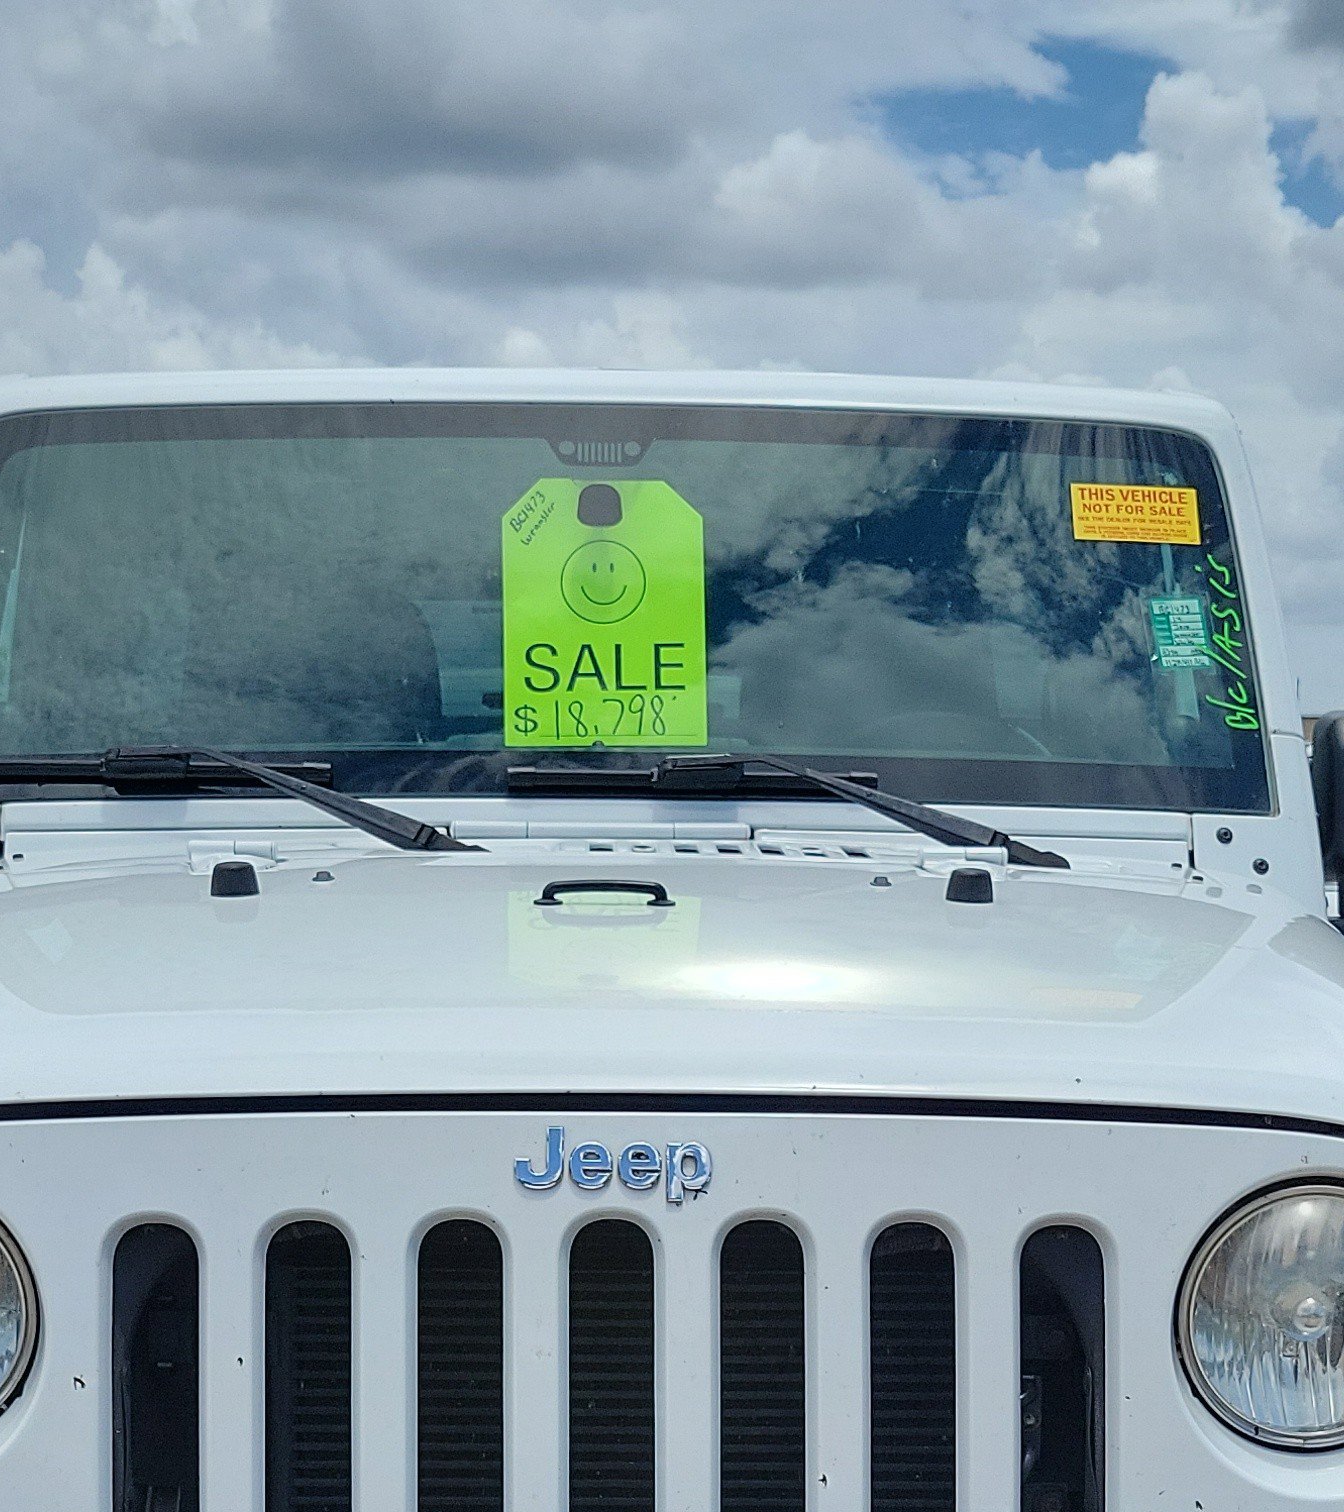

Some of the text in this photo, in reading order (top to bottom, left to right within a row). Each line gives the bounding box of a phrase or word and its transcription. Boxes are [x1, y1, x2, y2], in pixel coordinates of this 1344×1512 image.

[1078, 487, 1188, 505] THIS VEHICLE
[1082, 504, 1186, 518] NOT FOR SALE
[524, 642, 686, 693] SALE
[514, 1126, 713, 1202] Jeep
